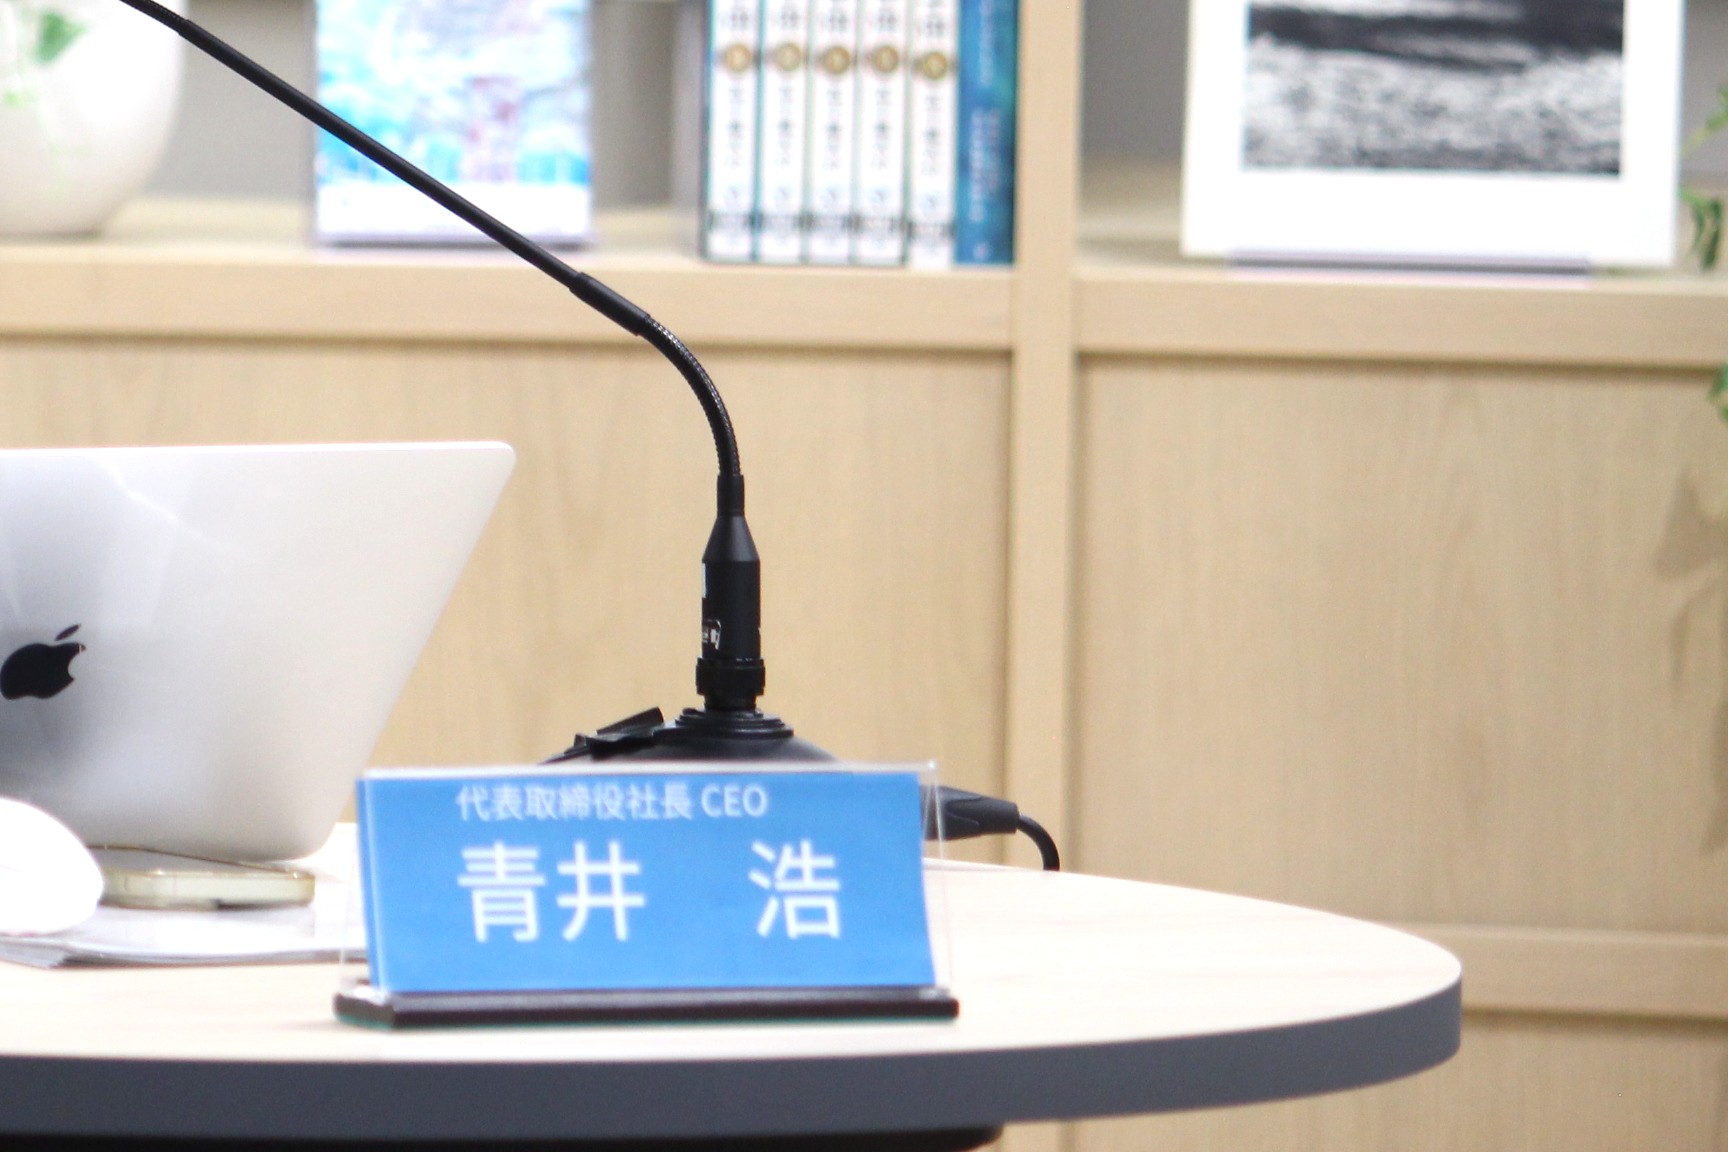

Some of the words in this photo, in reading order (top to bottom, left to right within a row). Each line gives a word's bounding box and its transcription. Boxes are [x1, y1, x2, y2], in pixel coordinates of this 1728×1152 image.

[457, 783, 693, 821] 代表取締役社長
[700, 783, 769, 819] CEO
[457, 840, 646, 943] 青井
[748, 837, 841, 939] 浩
